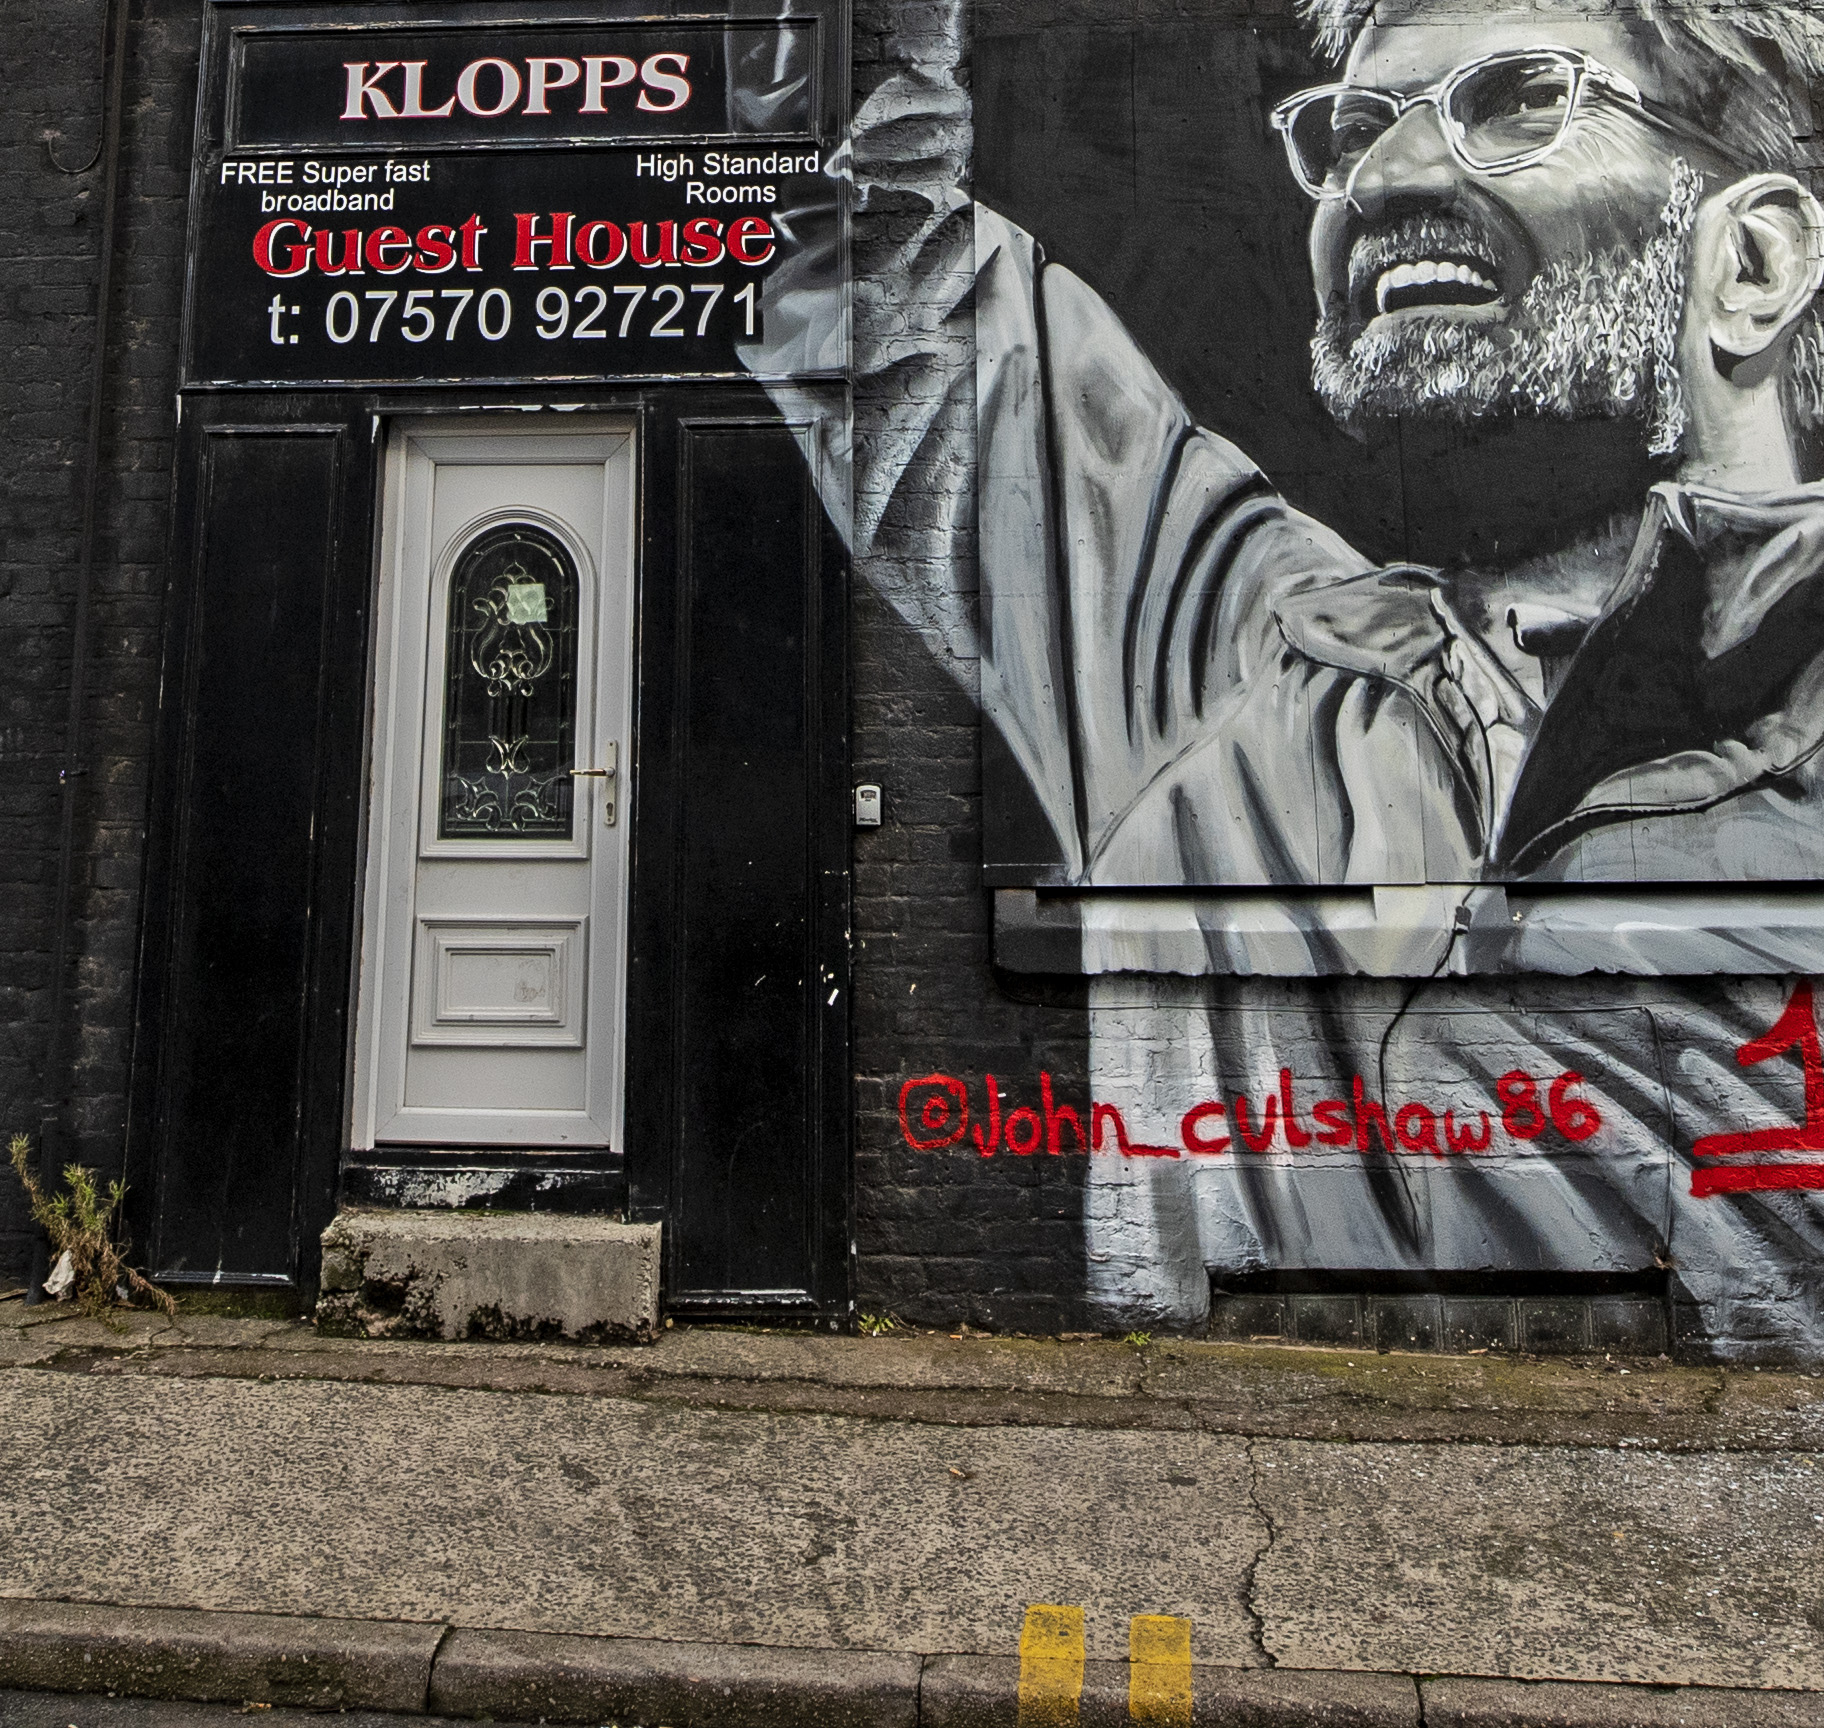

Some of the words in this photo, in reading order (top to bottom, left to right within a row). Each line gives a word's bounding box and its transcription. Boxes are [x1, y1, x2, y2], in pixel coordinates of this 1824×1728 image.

[339, 52, 692, 121] KLOPPS
[220, 160, 295, 185] FREE
[302, 159, 378, 189] Super
[384, 159, 432, 183] fast
[635, 153, 695, 181] High
[702, 150, 820, 176] Standard
[260, 187, 395, 213] broadband
[685, 181, 777, 205] Rooms
[252, 212, 489, 278] Guest
[510, 211, 777, 271] House
[267, 293, 301, 345] t:
[325, 287, 512, 344] 07570
[535, 282, 755, 340] 927271
